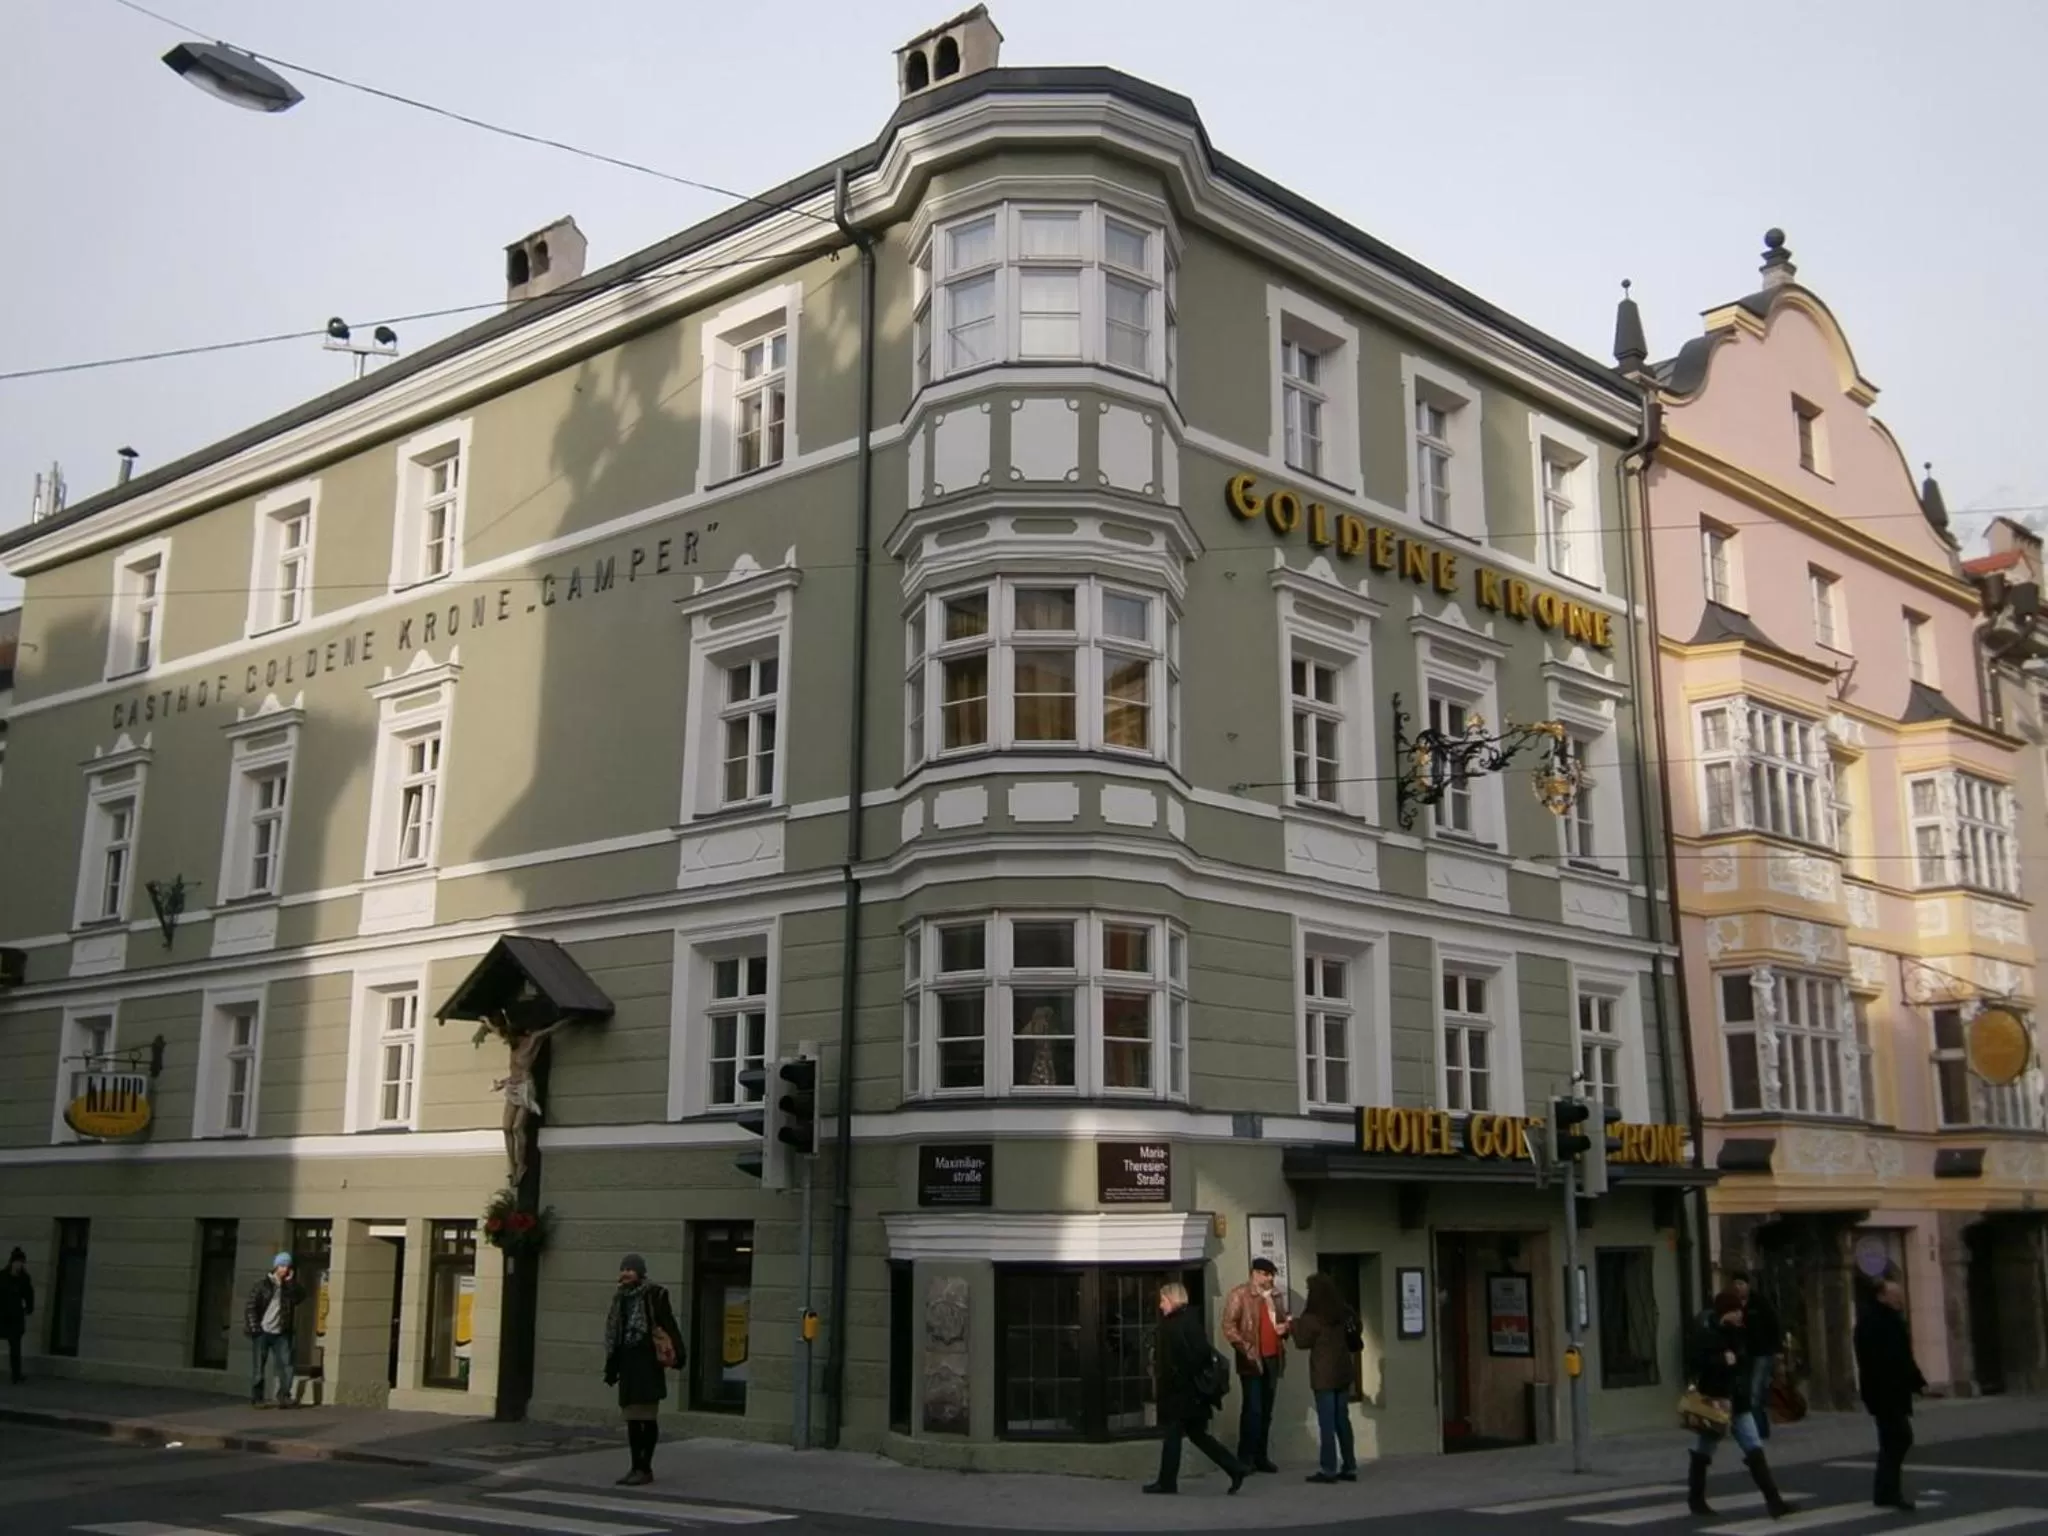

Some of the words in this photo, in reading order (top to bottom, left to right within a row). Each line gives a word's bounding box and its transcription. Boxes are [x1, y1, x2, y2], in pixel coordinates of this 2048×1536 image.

[1225, 472, 1459, 595] GOLDENE
[1474, 566, 1614, 650] KRONE
[112, 674, 229, 730] GASTHOF
[245, 630, 375, 695] GOLDENE
[398, 588, 512, 650] KRONE
[1140, 1146, 1168, 1158] Maria-
[1360, 1106, 1457, 1156] HOTEL
